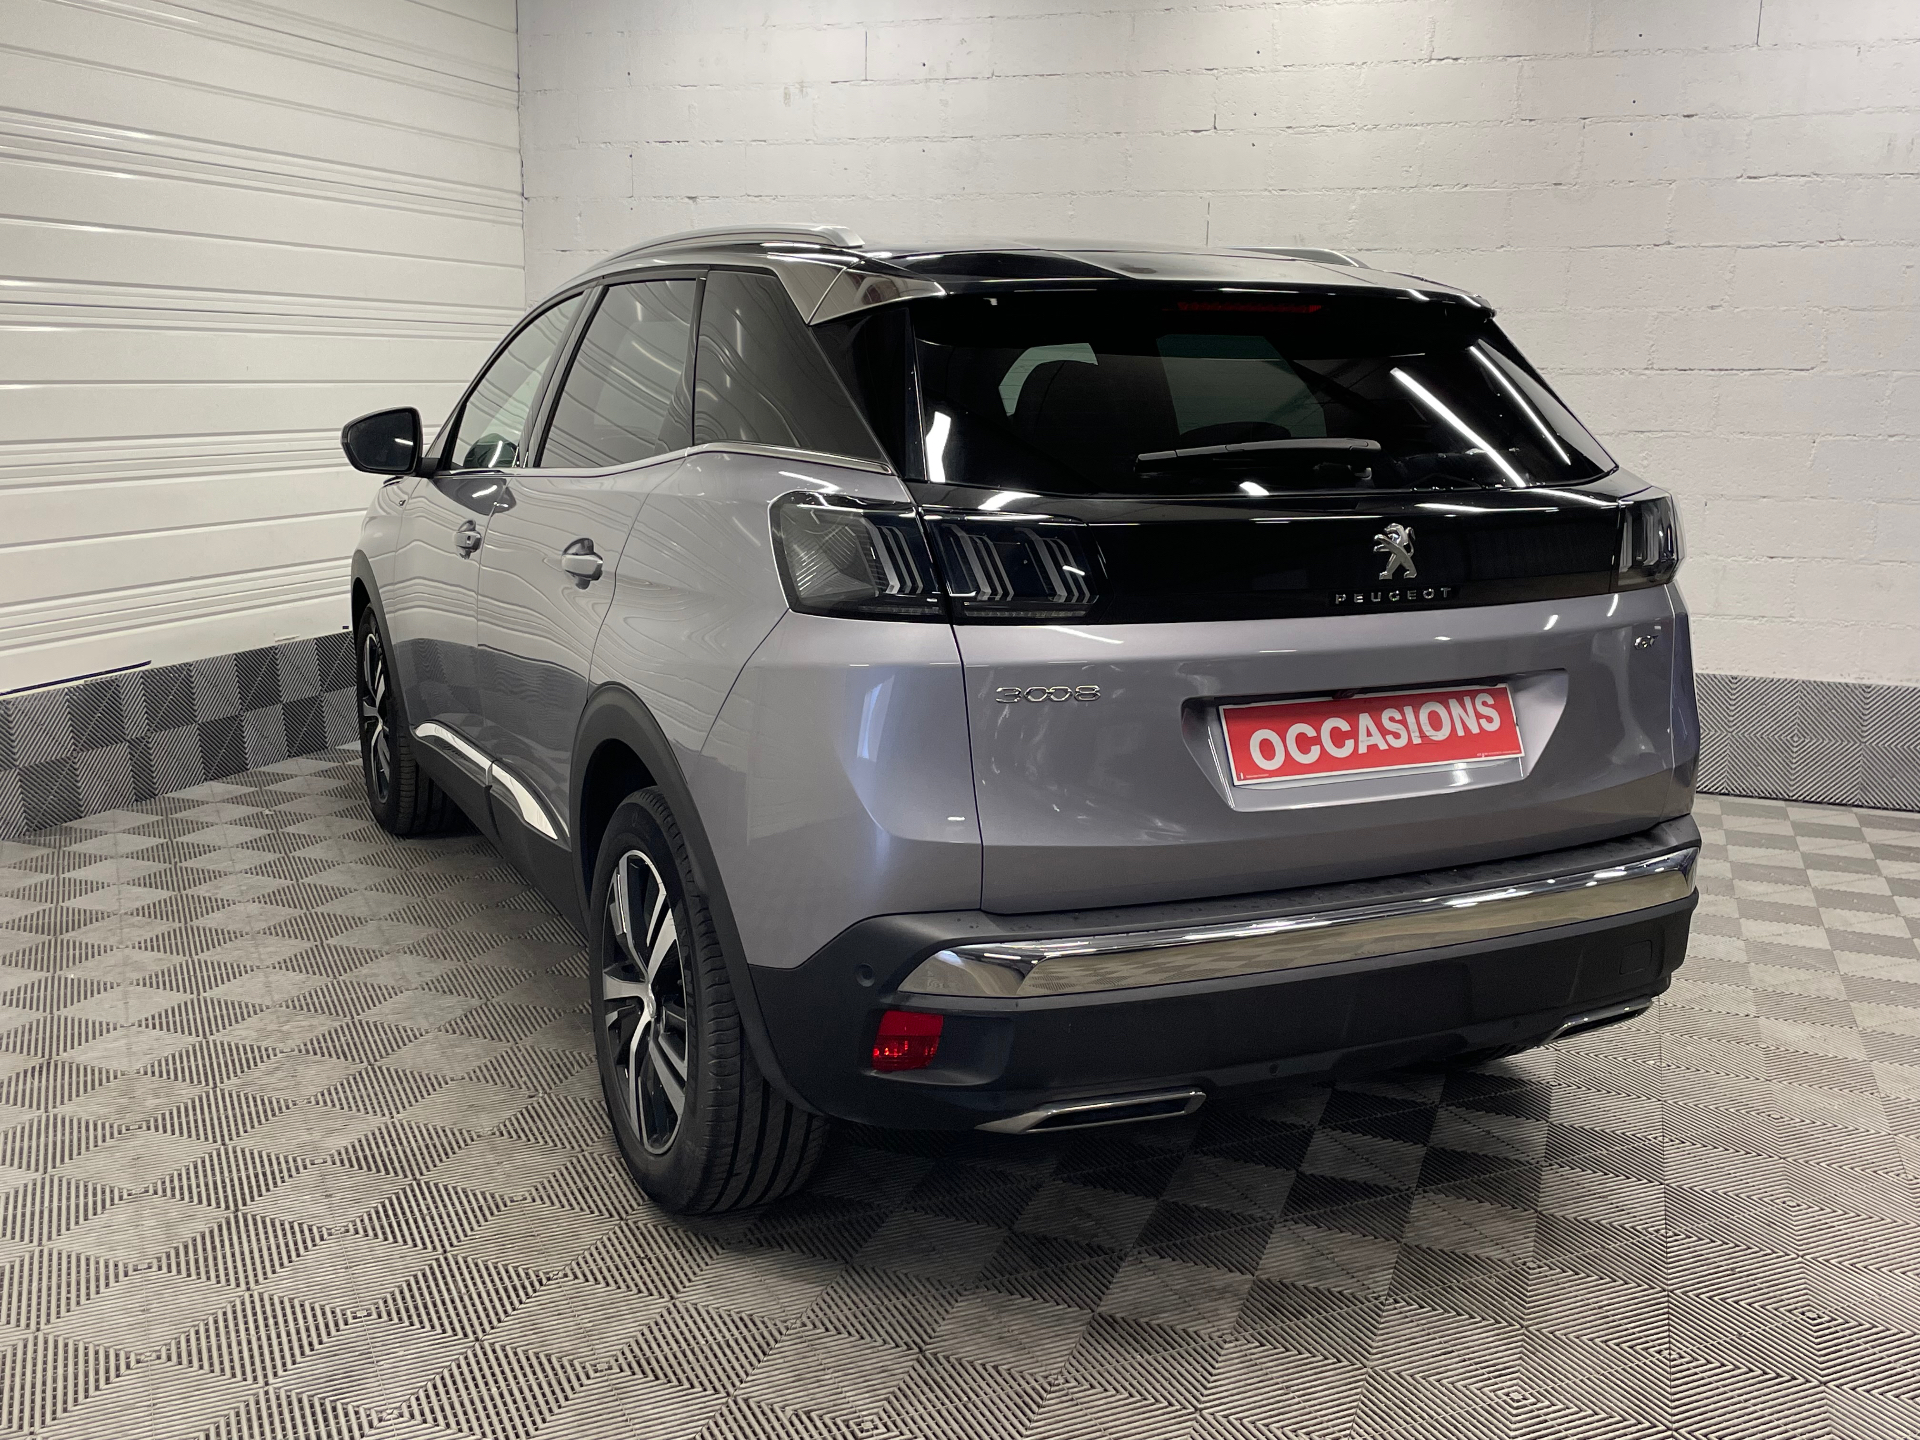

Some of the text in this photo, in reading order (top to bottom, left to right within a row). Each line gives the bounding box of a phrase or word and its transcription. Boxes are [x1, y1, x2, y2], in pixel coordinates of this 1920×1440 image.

[1335, 587, 1451, 604] PEUGEOT
[996, 685, 1101, 703] 3008
[1249, 692, 1501, 771] OCCASIONS
